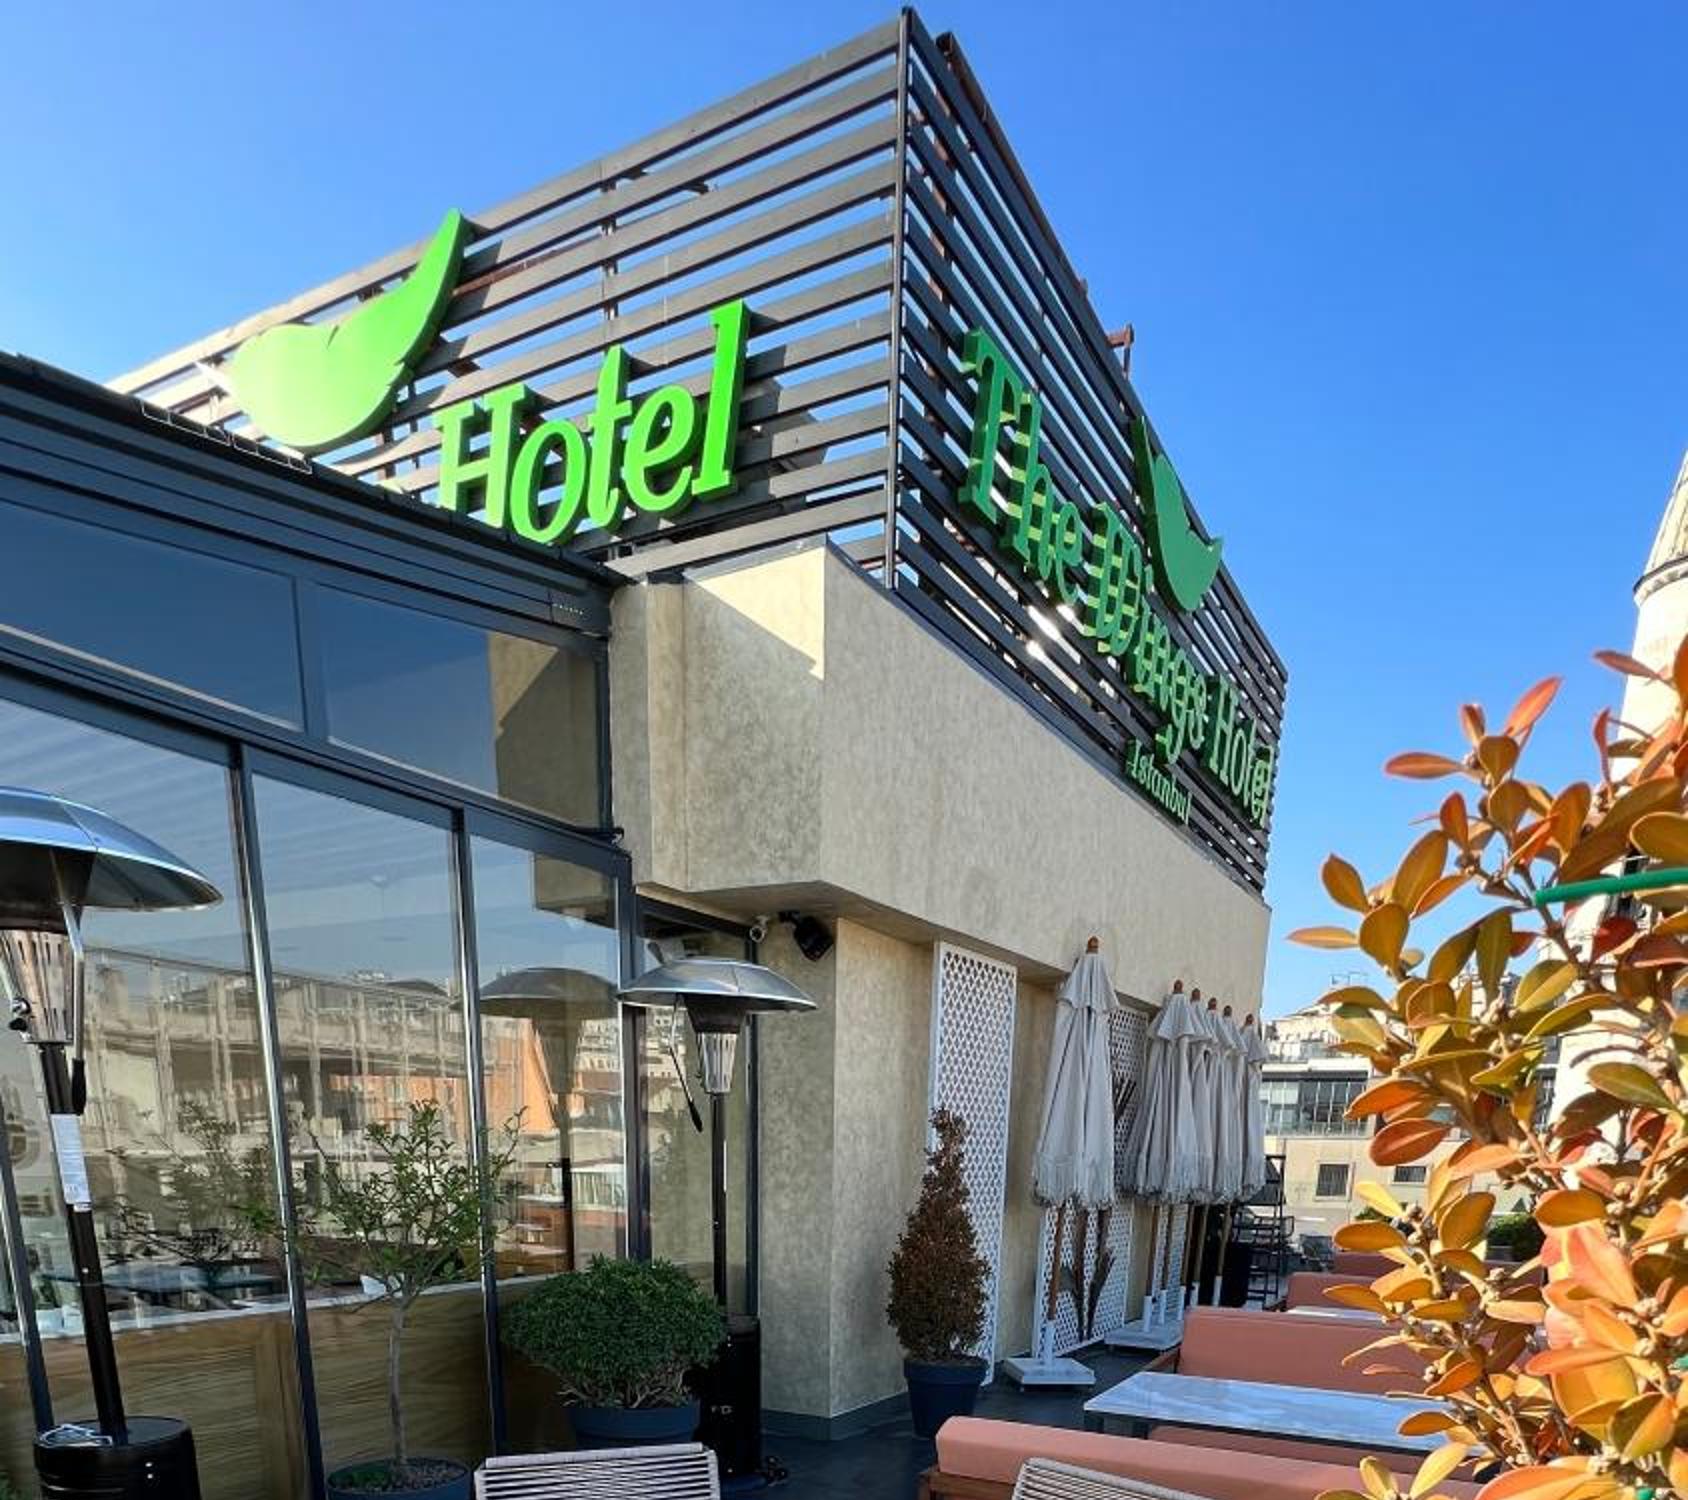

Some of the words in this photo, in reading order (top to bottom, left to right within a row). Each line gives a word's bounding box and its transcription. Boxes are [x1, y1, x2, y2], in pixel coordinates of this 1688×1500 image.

[432, 298, 752, 545] Hotel
[958, 326, 1083, 604] The
[1206, 673, 1275, 830] Hotel
[1126, 737, 1192, 826] Istanbul
